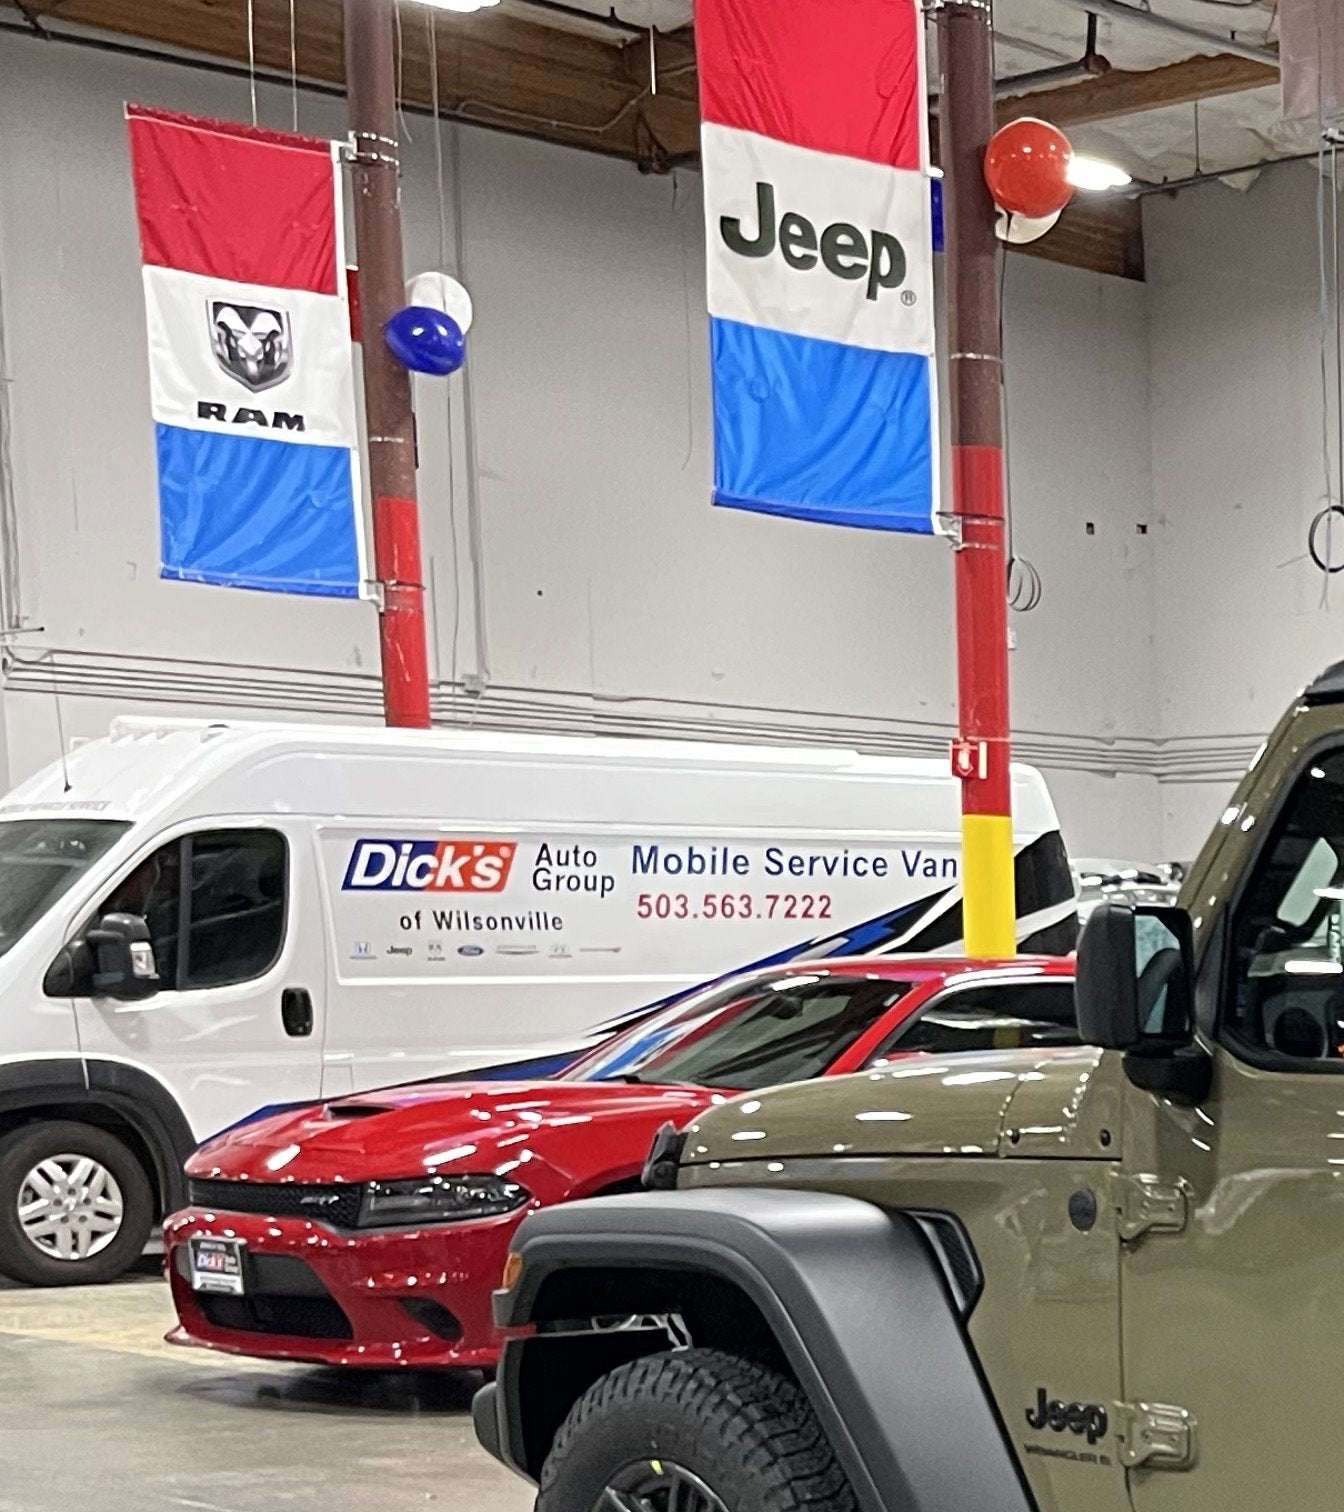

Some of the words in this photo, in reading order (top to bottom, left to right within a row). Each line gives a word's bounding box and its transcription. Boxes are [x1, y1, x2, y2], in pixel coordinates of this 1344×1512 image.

[719, 181, 907, 301] Jeep
[197, 400, 306, 432] RAM
[350, 842, 504, 889] Dick's
[535, 842, 598, 868] Auto
[631, 845, 750, 876] Mobile
[764, 847, 889, 878] Service
[901, 849, 958, 879] Van
[532, 867, 616, 898] Group
[399, 911, 423, 931] of
[432, 909, 563, 932] Wilsonville
[636, 892, 833, 920] 503.563.7222
[386, 945, 413, 956] Jeep
[1025, 1387, 1109, 1445] Jeep
